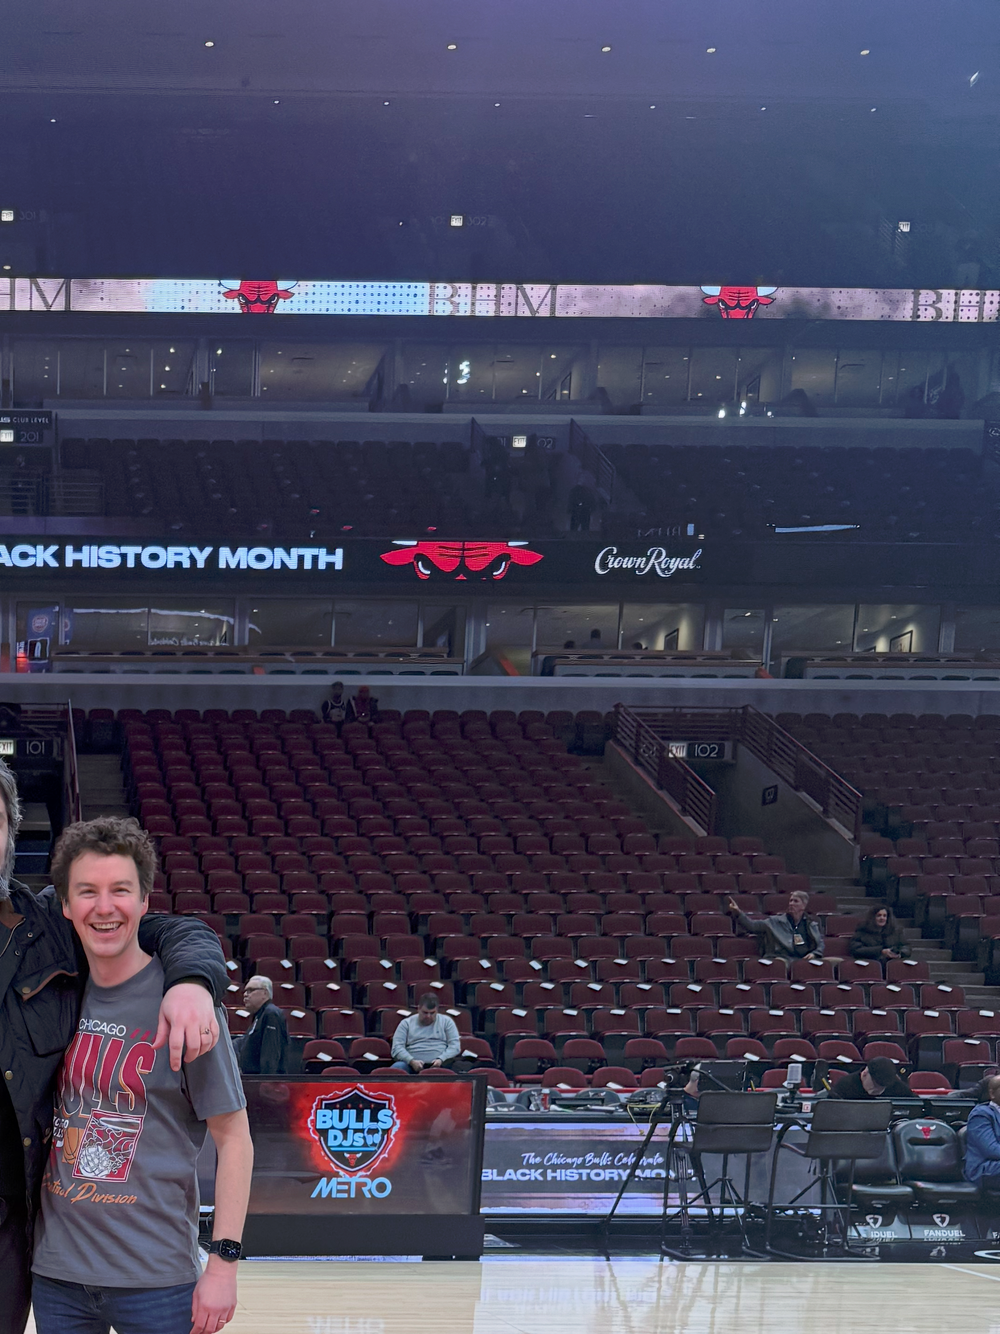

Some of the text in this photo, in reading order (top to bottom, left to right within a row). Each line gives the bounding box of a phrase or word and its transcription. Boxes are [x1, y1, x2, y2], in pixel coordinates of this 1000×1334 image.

[429, 282, 557, 317] BHM
[911, 289, 1000, 322] BH
[65, 544, 213, 569] HISTORY
[218, 547, 344, 571] MONTH
[594, 546, 703, 577] Crown Royal
[26, 740, 45, 755] 101
[694, 743, 719, 757] 102
[78, 1018, 126, 1037] CHICAGO
[59, 1031, 157, 1118] ULLS
[316, 1108, 394, 1130] BULLS
[327, 1128, 364, 1147] DJs
[521, 1152, 542, 1166] The
[543, 1152, 584, 1168] Chicago
[584, 1152, 612, 1167] Bulls
[481, 1168, 544, 1182] BLACK
[546, 1168, 632, 1182] HISTORY
[70, 1182, 138, 1204] Division
[310, 1177, 392, 1199] METRO
[923, 1228, 967, 1238] FANDUEL
